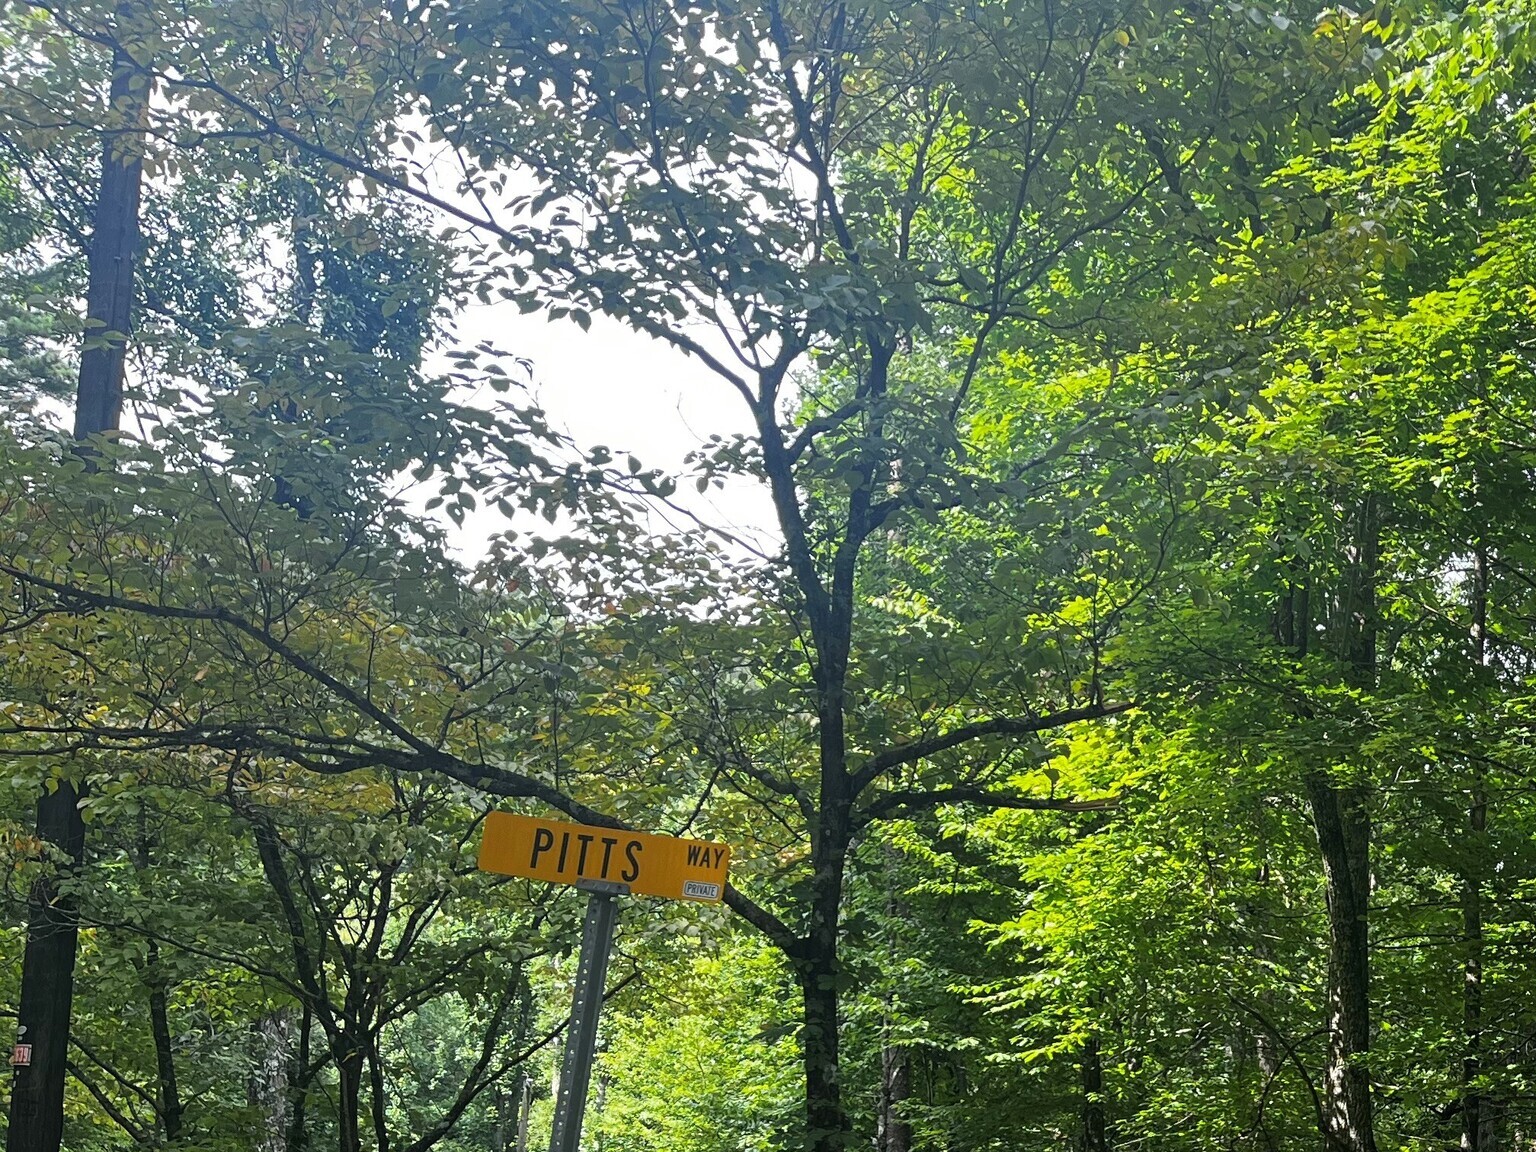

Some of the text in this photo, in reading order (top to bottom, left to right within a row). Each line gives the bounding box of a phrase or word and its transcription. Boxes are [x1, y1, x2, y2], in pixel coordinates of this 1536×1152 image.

[529, 828, 725, 882] PITTS WAY
[687, 882, 716, 898] PRIVATE
